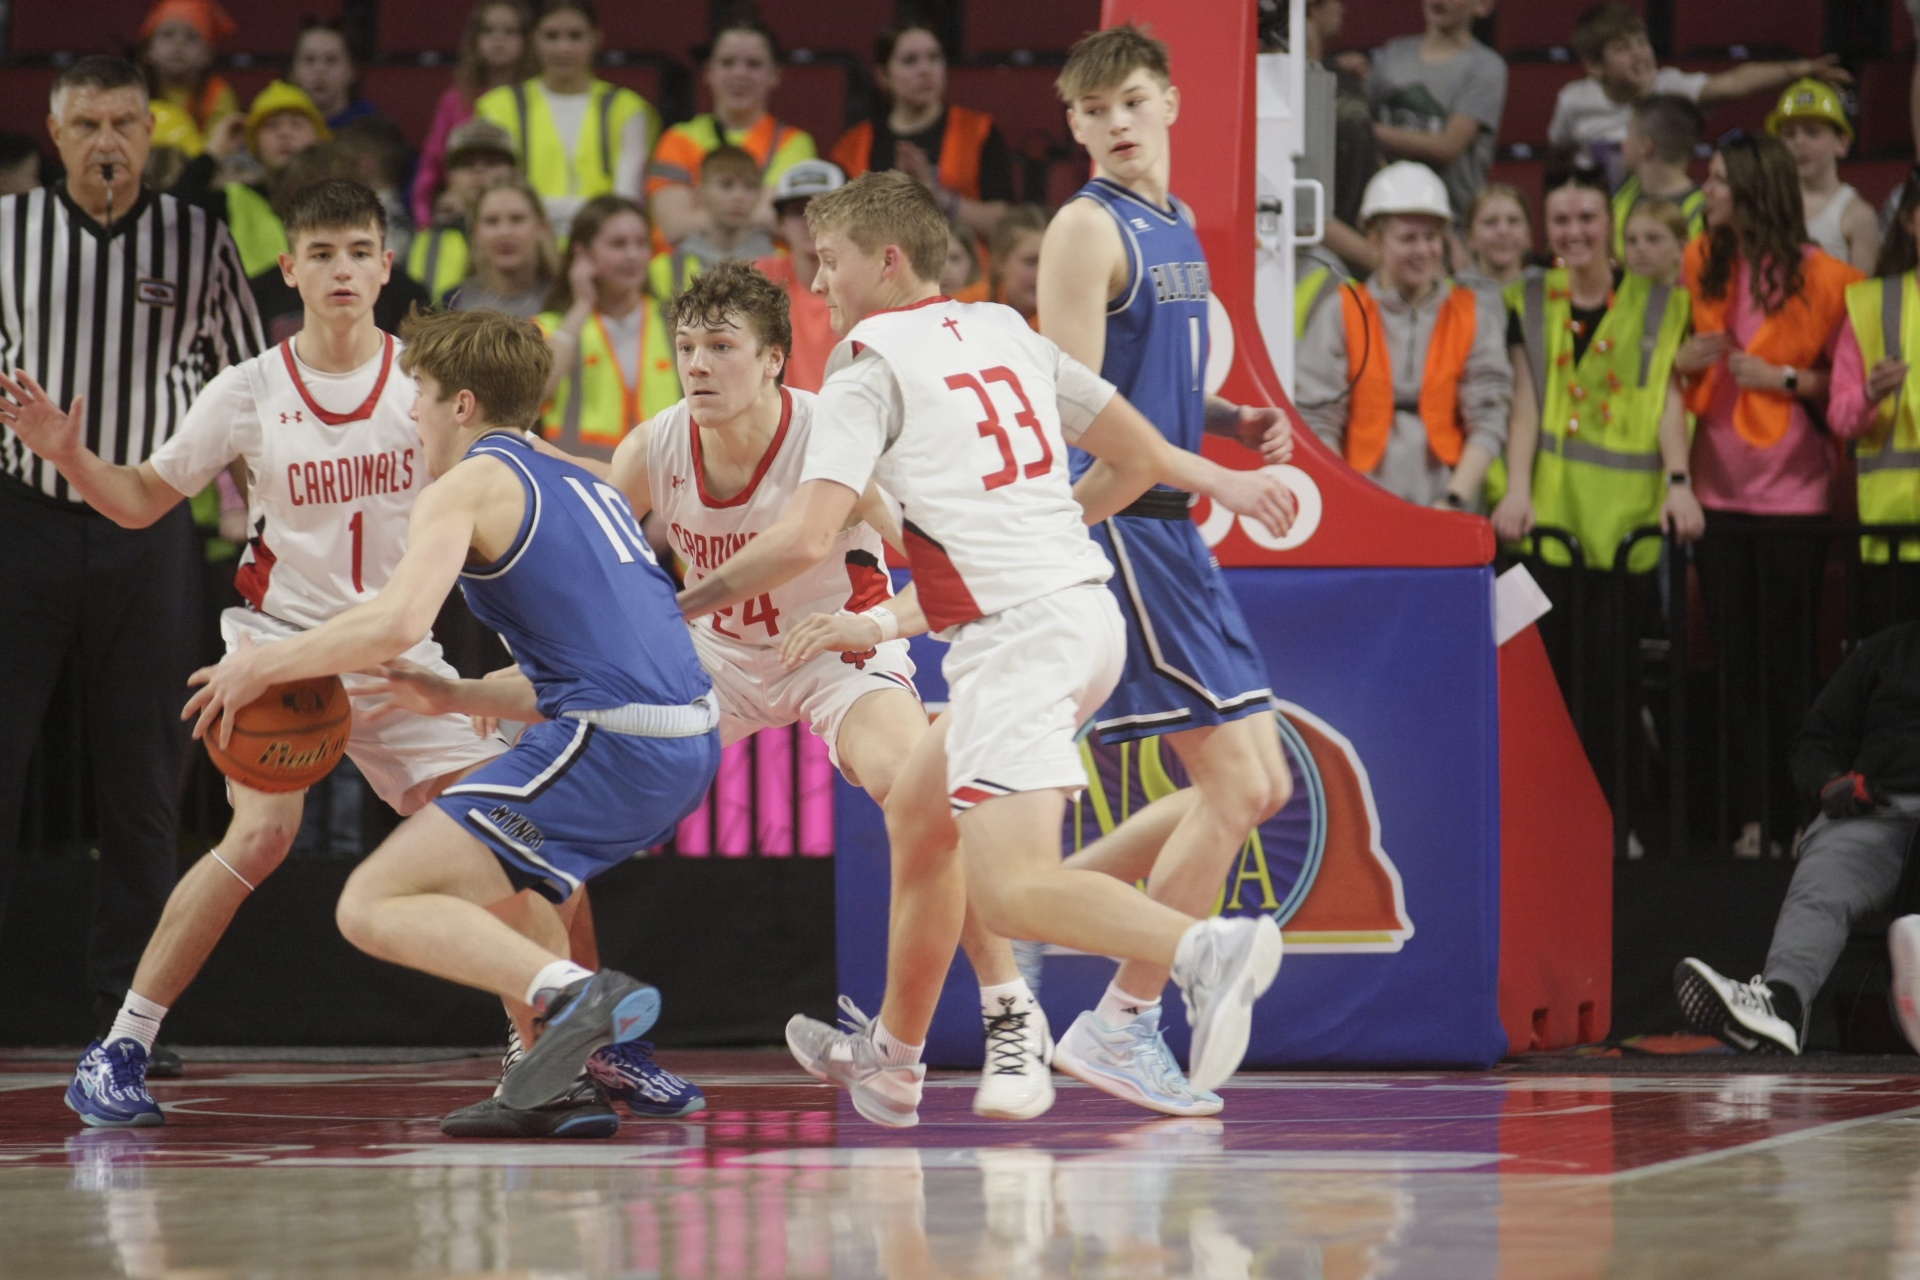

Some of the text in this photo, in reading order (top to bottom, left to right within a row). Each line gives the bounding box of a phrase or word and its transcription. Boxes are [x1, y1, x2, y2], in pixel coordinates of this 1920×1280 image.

[1189, 316, 1200, 392] 1
[943, 365, 1054, 492] 33
[287, 448, 414, 507] CARDINALS
[348, 511, 365, 594] 1
[562, 475, 660, 567] 10
[671, 522, 759, 570] CARDIN
